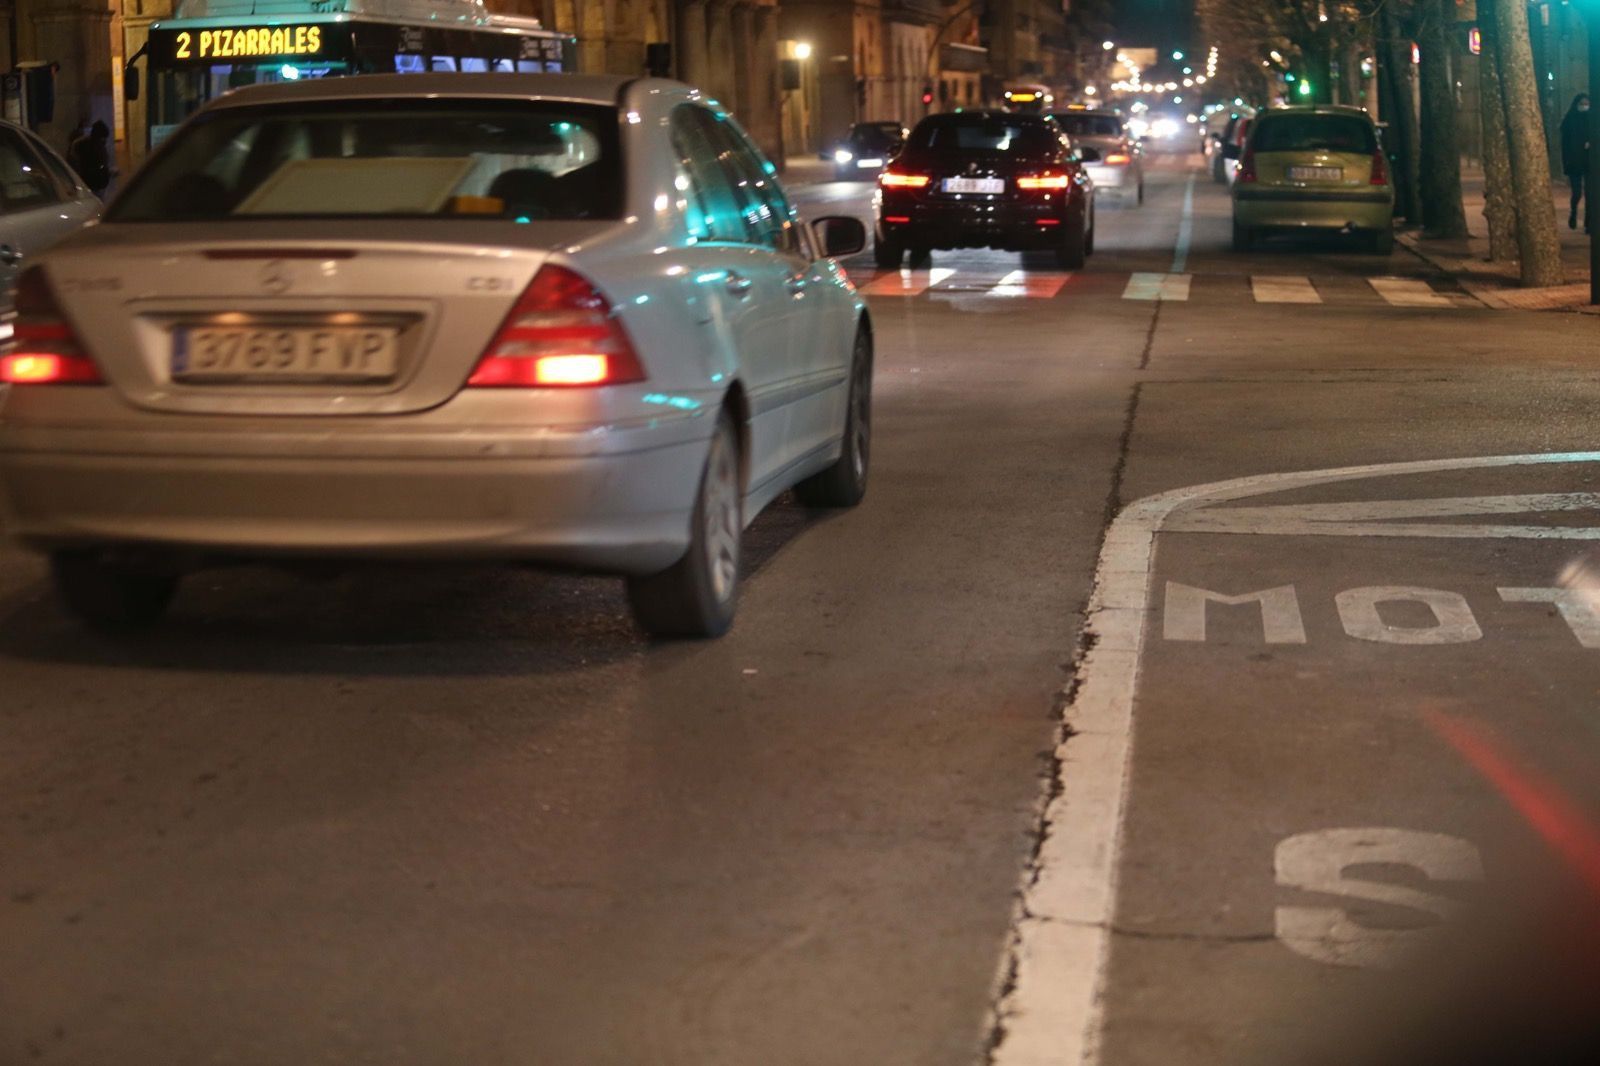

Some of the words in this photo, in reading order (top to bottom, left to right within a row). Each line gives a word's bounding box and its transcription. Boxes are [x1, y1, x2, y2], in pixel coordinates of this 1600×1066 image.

[176, 31, 191, 58] 2
[199, 26, 321, 57] PIZARRALES
[196, 331, 296, 368] 3769
[306, 331, 386, 368] FVP
